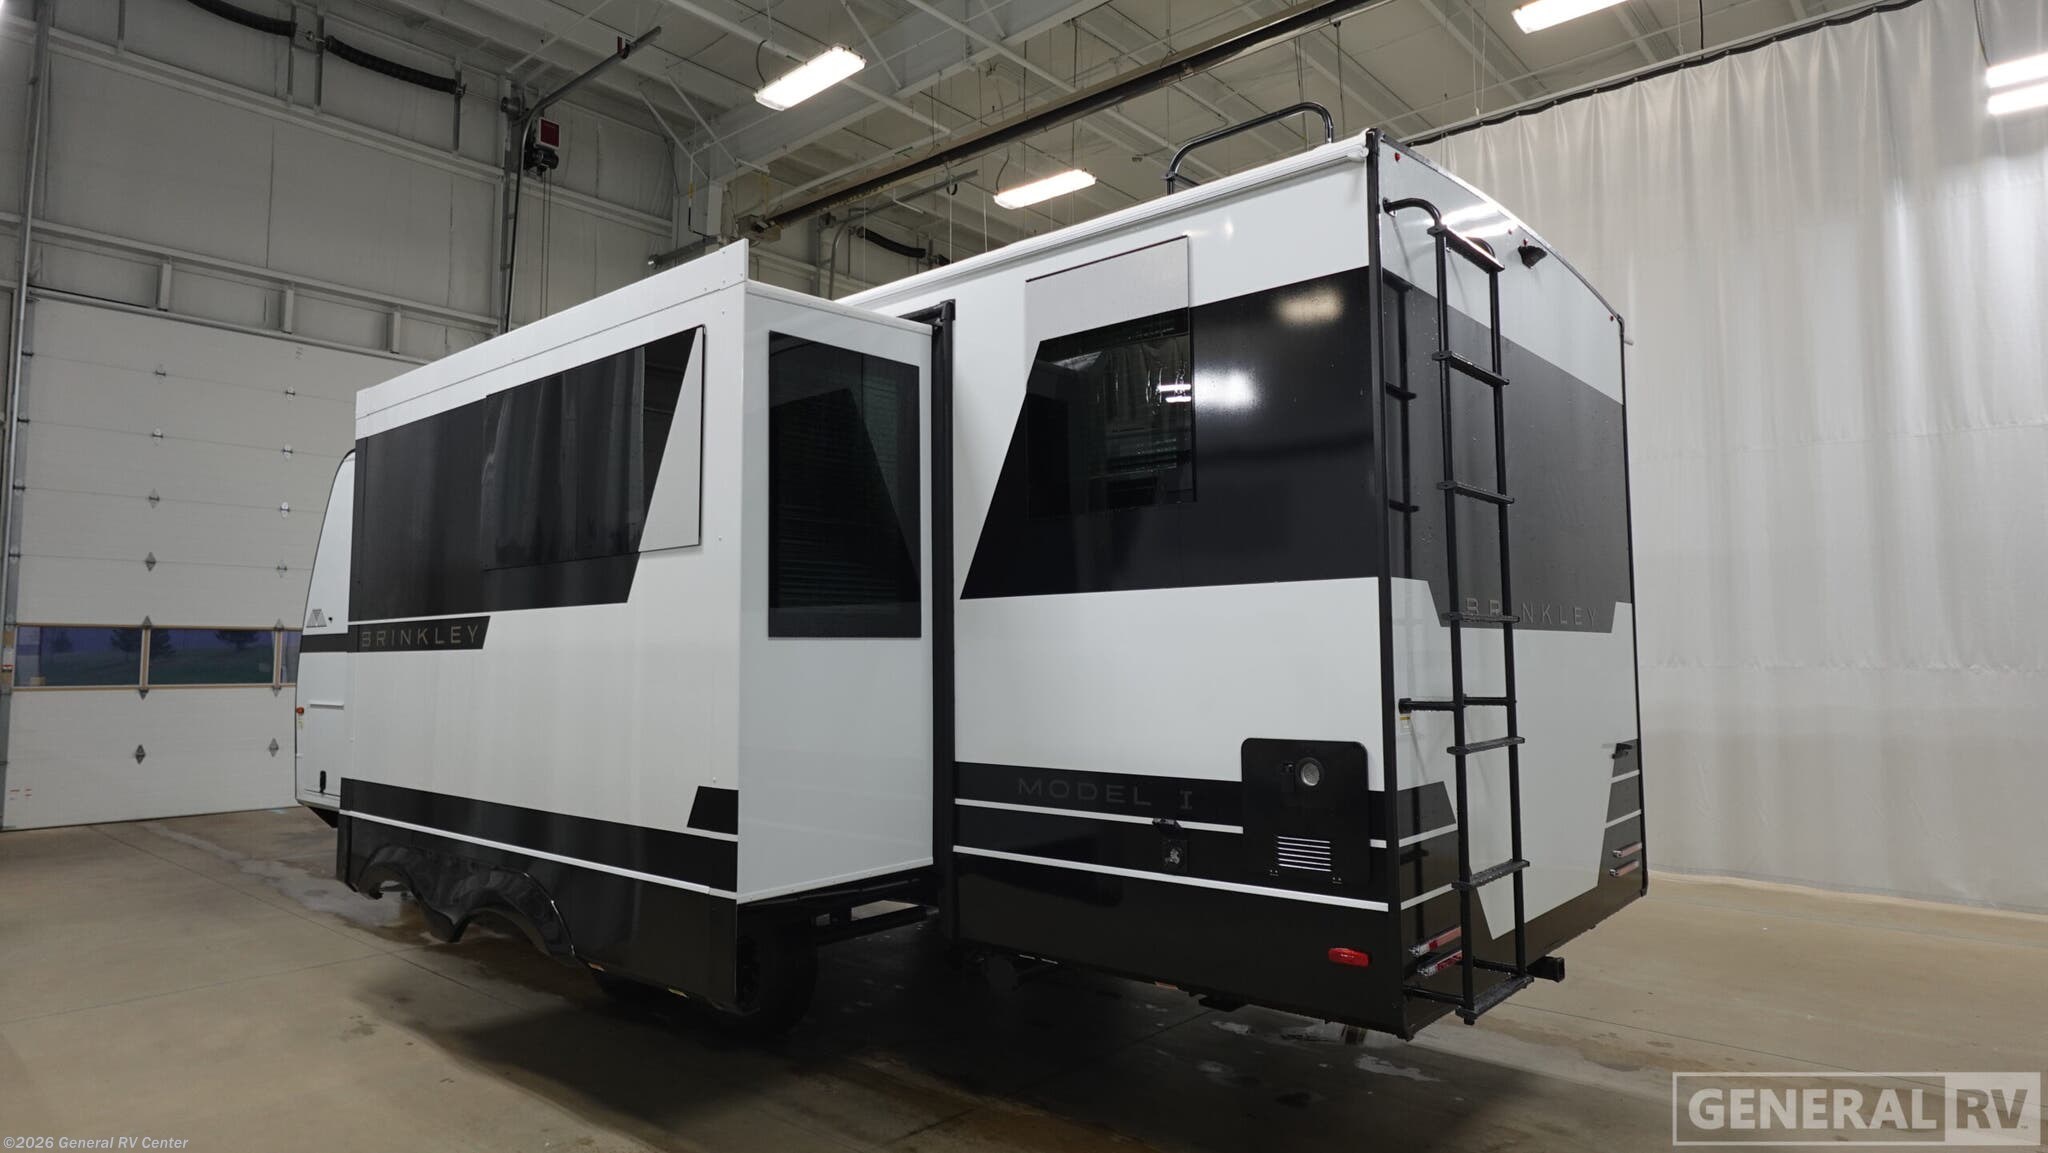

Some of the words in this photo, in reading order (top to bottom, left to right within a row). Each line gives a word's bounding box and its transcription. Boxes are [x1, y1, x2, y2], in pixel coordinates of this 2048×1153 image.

[1466, 597, 1598, 626] BRNKLEY
[361, 624, 479, 648] BRINKLEY
[1017, 777, 1152, 806] MODEL
